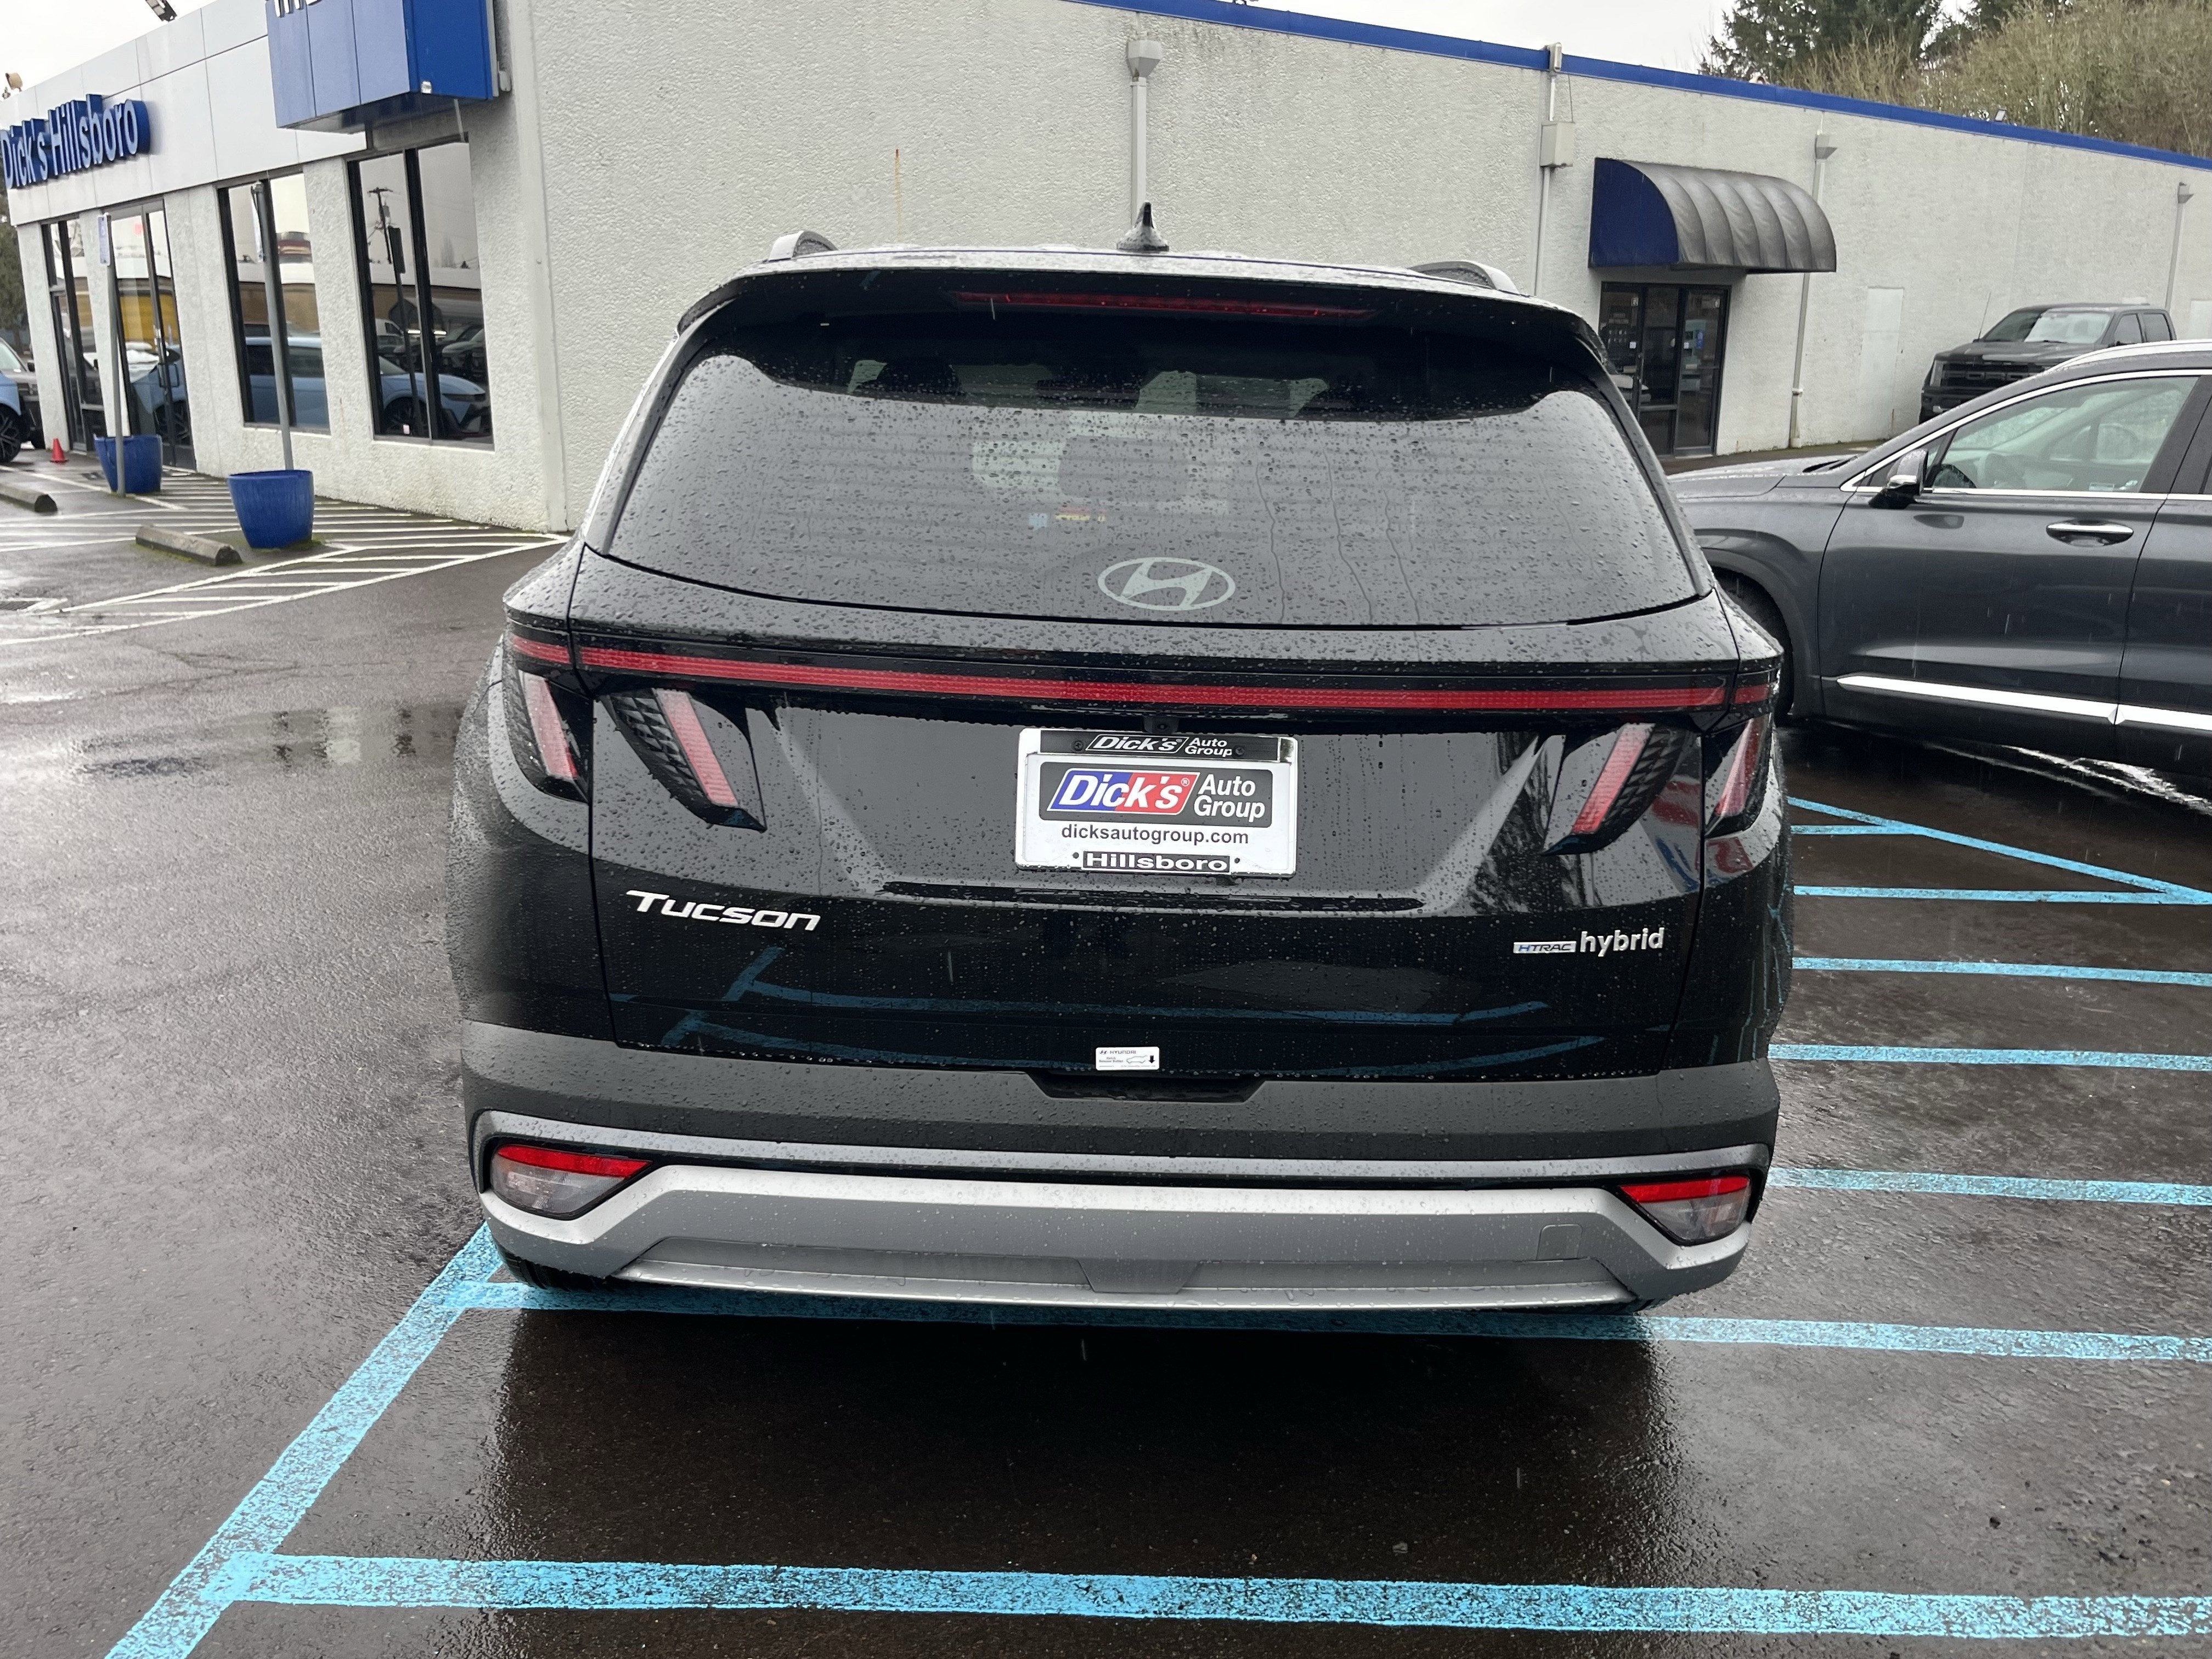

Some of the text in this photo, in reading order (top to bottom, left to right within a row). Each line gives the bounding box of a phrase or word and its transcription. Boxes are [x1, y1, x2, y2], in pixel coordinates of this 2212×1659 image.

[1, 94, 138, 189] Dick's Hillsboro
[1093, 736, 1178, 751] Dick's
[1185, 746, 1232, 757] Group
[1189, 737, 1228, 748] Auto
[1198, 774, 1256, 797] Auto
[1194, 795, 1265, 823] Group
[1062, 824, 1249, 845] dicksautogroup.com
[1087, 853, 1228, 871] Hillsboro
[1518, 927, 1664, 957] HTRAC hybrid
